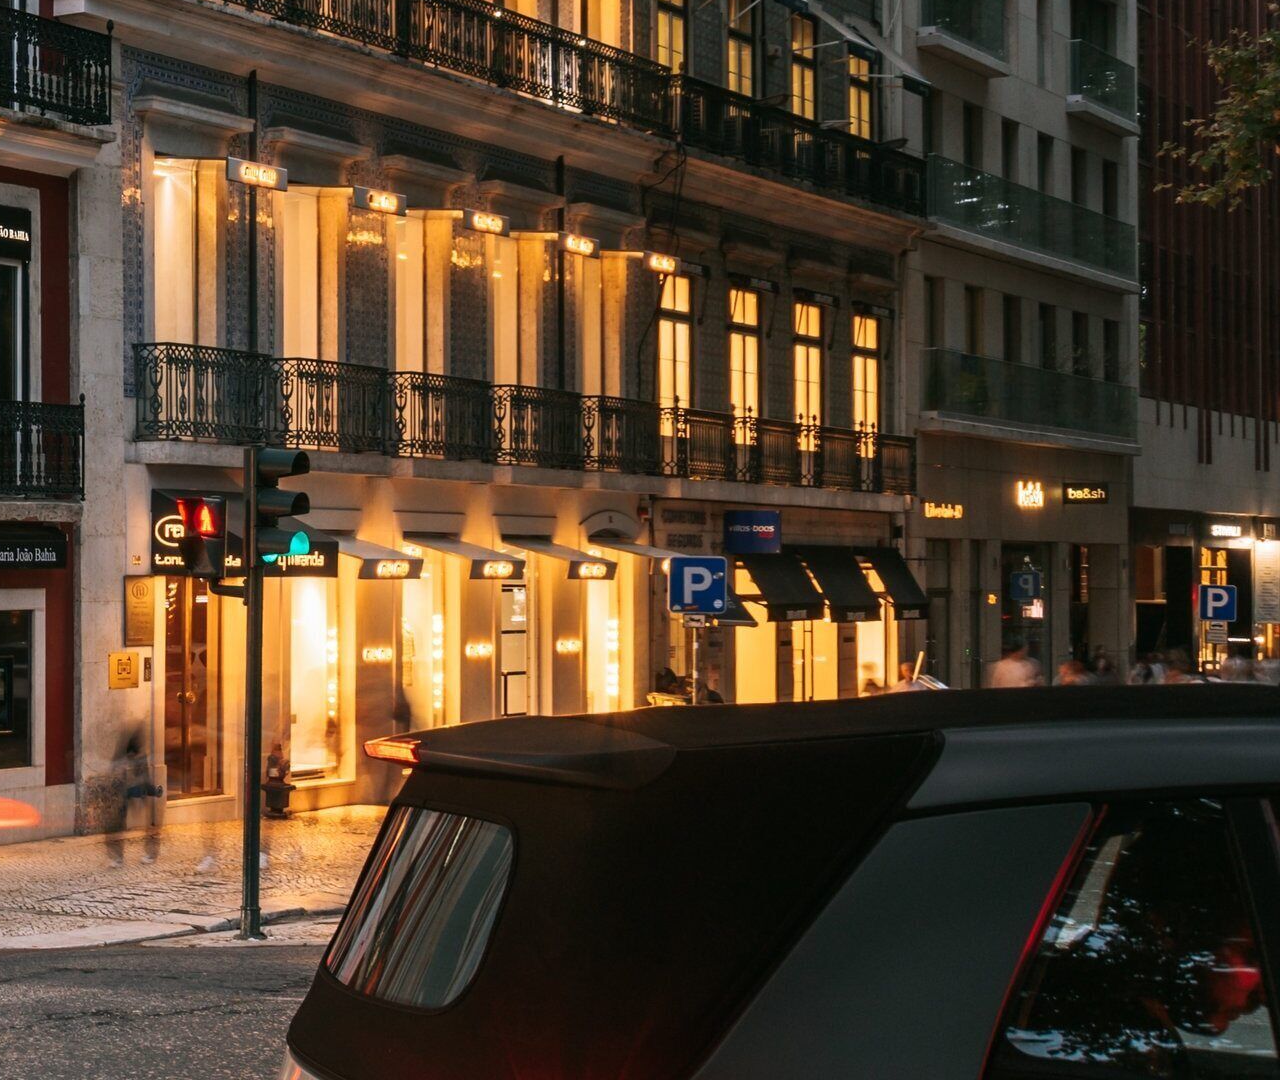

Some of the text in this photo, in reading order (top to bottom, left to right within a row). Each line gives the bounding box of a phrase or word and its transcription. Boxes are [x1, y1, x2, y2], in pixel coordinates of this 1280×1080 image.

[9, 229, 30, 242] BAHIA
[1067, 488, 1106, 500] ba&sh
[15, 547, 33, 562] João
[35, 547, 57, 562] Bahia
